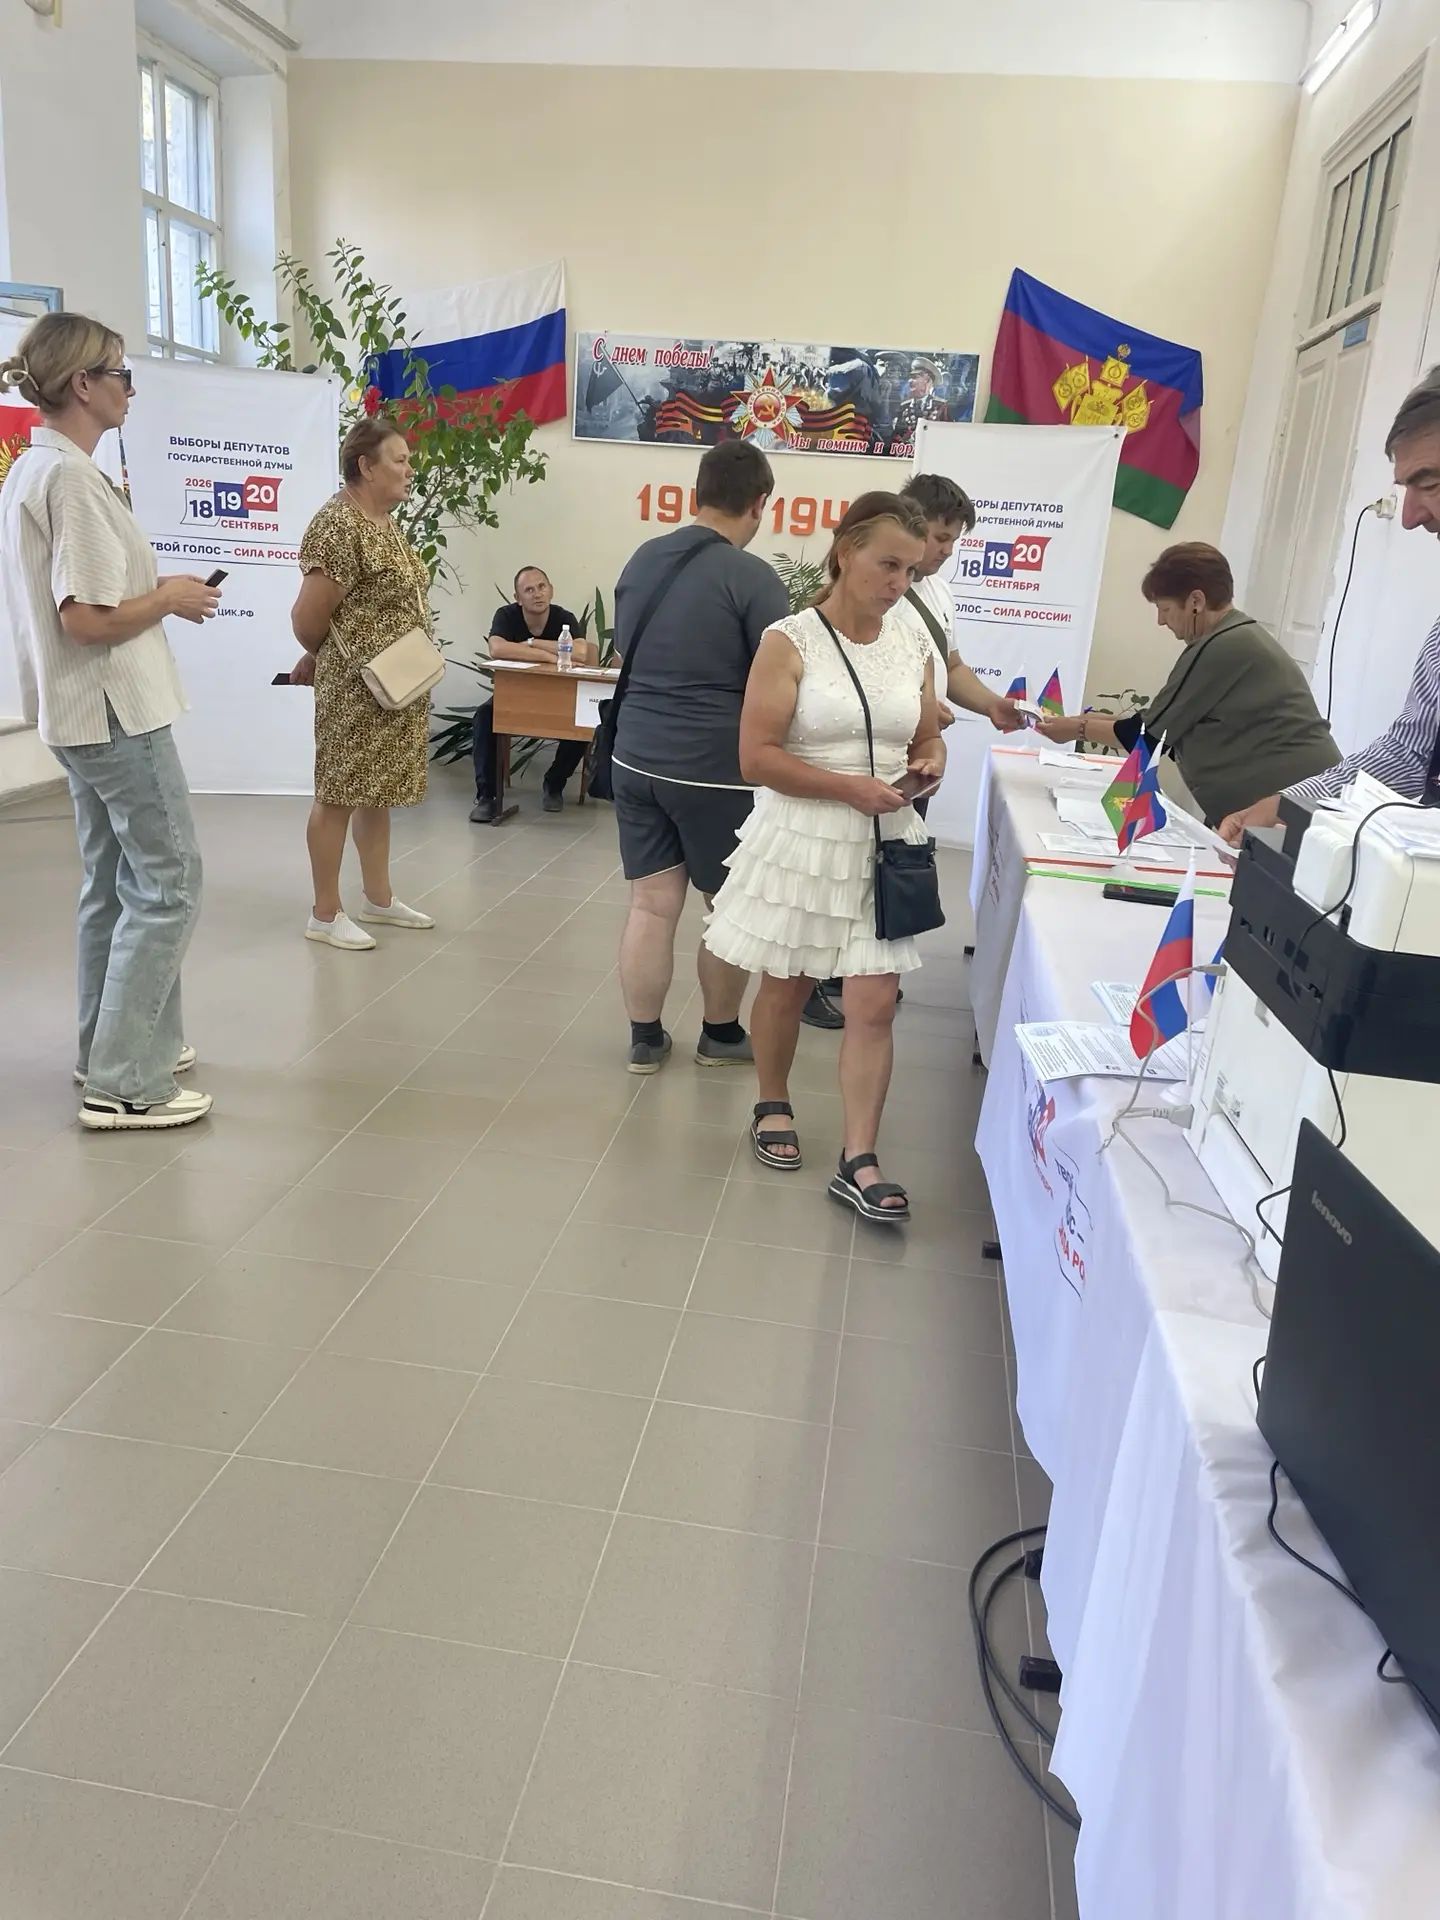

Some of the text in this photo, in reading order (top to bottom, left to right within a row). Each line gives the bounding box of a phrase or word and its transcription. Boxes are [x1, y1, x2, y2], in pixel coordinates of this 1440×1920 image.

[593, 337, 714, 370] С днем победы!
[169, 436, 290, 455] ВЫБОРЫ ДЕПУТАТОВ
[787, 432, 915, 458] Мы помним и гор
[168, 452, 293, 470] ГОСУДАРСТВЕННОЙ ДУМЫ
[185, 478, 212, 488] 2026
[189, 484, 275, 518] 18 19 20
[637, 484, 849, 536] 19 194
[1000, 501, 1063, 513] ДЕПУТАТОВ
[220, 520, 279, 532] СЕНТЯБРЯ
[976, 516, 1064, 528] АРСТВЕННОЙ ДУМЫ
[150, 542, 180, 551] ТВОЙ
[183, 544, 221, 555] ГОЛОС
[234, 548, 265, 558] СИЛА
[267, 551, 301, 561] РОСС
[960, 538, 984, 548] 2026
[961, 544, 1041, 578] 18 19 20
[986, 579, 1040, 592] СЕНТЯБРЯ
[217, 608, 254, 618] ЦИК.РФ
[955, 603, 982, 614] ОЛОС
[993, 607, 1021, 618] СИЛА
[1024, 610, 1072, 622] РОССИИ!
[1311, 1190, 1352, 1246] lenovo
